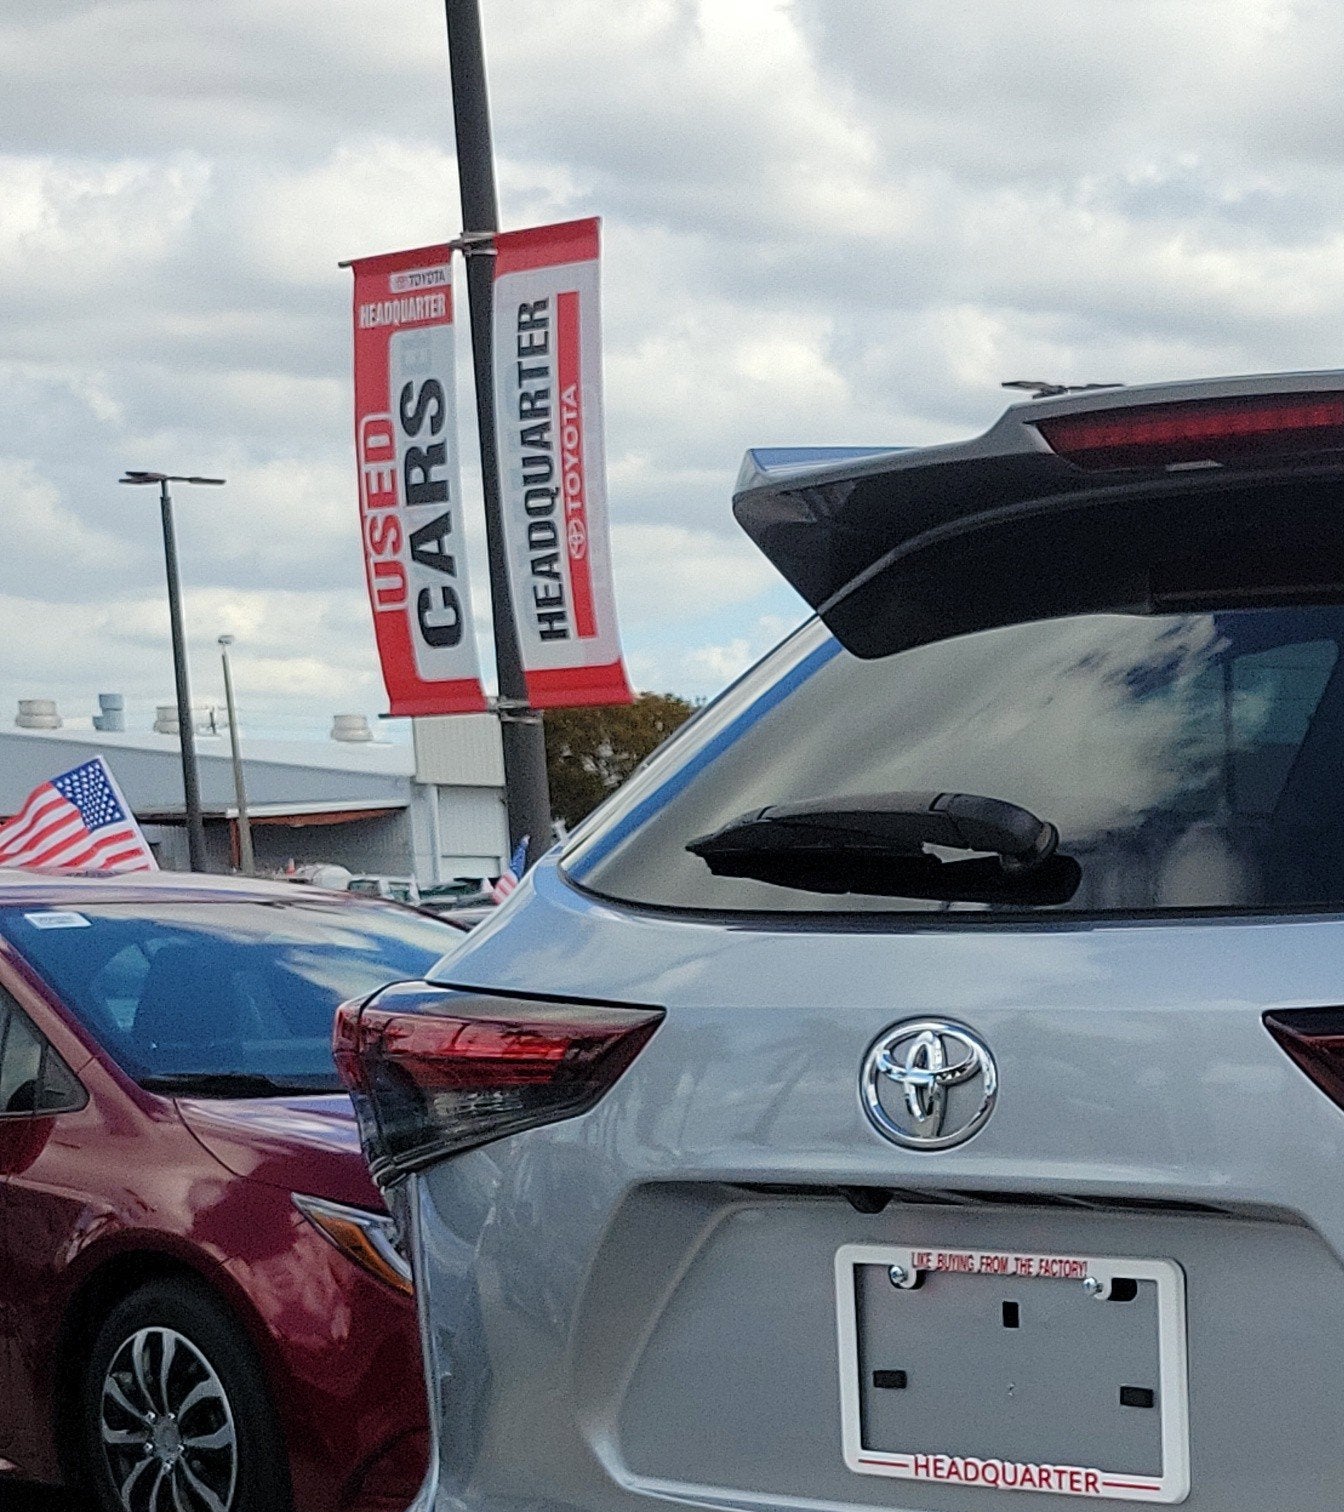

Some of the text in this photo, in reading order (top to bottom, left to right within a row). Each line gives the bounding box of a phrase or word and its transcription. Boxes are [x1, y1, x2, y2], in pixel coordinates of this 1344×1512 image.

[360, 293, 447, 329] HEADQUARTER
[408, 269, 446, 287] TOYOTA
[517, 297, 571, 642] HEADQUARTER
[561, 383, 583, 516] TOYOTA
[361, 412, 409, 612] USED
[399, 377, 466, 650] CARS
[911, 1251, 933, 1269] LIKE
[936, 1253, 975, 1273] BUYING
[979, 1255, 1009, 1274] FROM
[1014, 1256, 1034, 1276] THE
[914, 1455, 1101, 1494] HEADQUARTER
